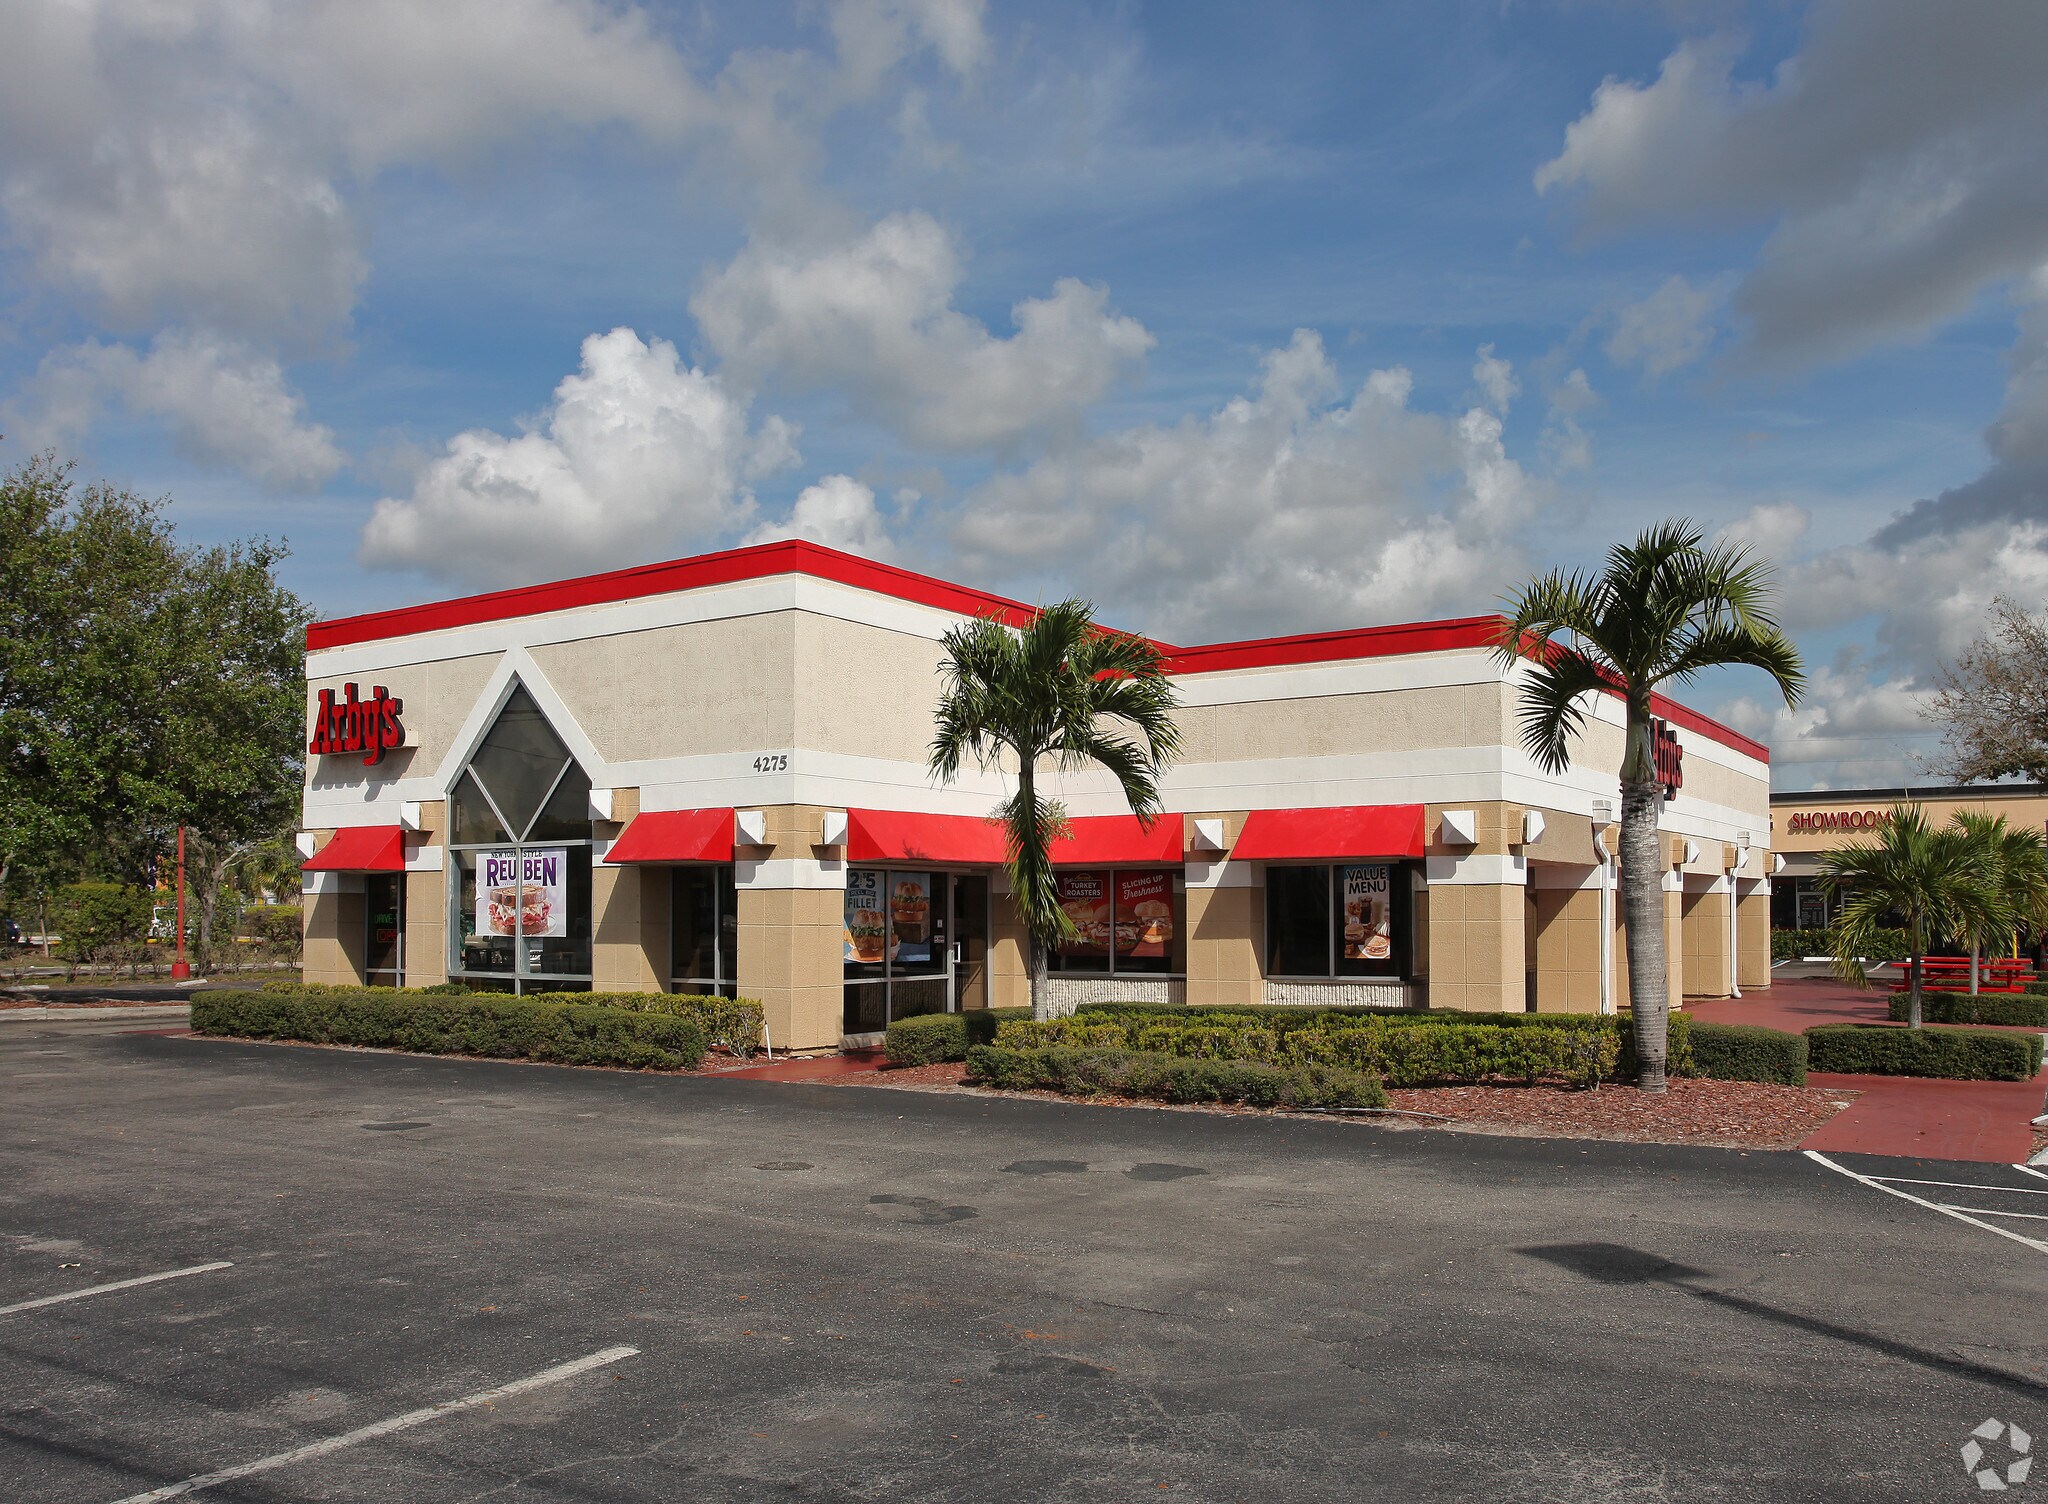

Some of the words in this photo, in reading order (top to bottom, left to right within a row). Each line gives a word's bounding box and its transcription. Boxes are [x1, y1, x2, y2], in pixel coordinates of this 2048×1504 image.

[310, 682, 402, 766] Arby's
[753, 755, 788, 773] 4275
[1791, 810, 1891, 829] SHOWROOM
[523, 850, 543, 858] STYLE
[486, 857, 557, 887] REUBEN
[1347, 867, 1387, 881] VALUE
[849, 872, 859, 889] 2
[1122, 877, 1152, 890] SLICING
[1152, 874, 1163, 883] UP
[1348, 880, 1387, 894] MENU
[1123, 885, 1164, 900] Freshness
[847, 897, 877, 909] FILLET
